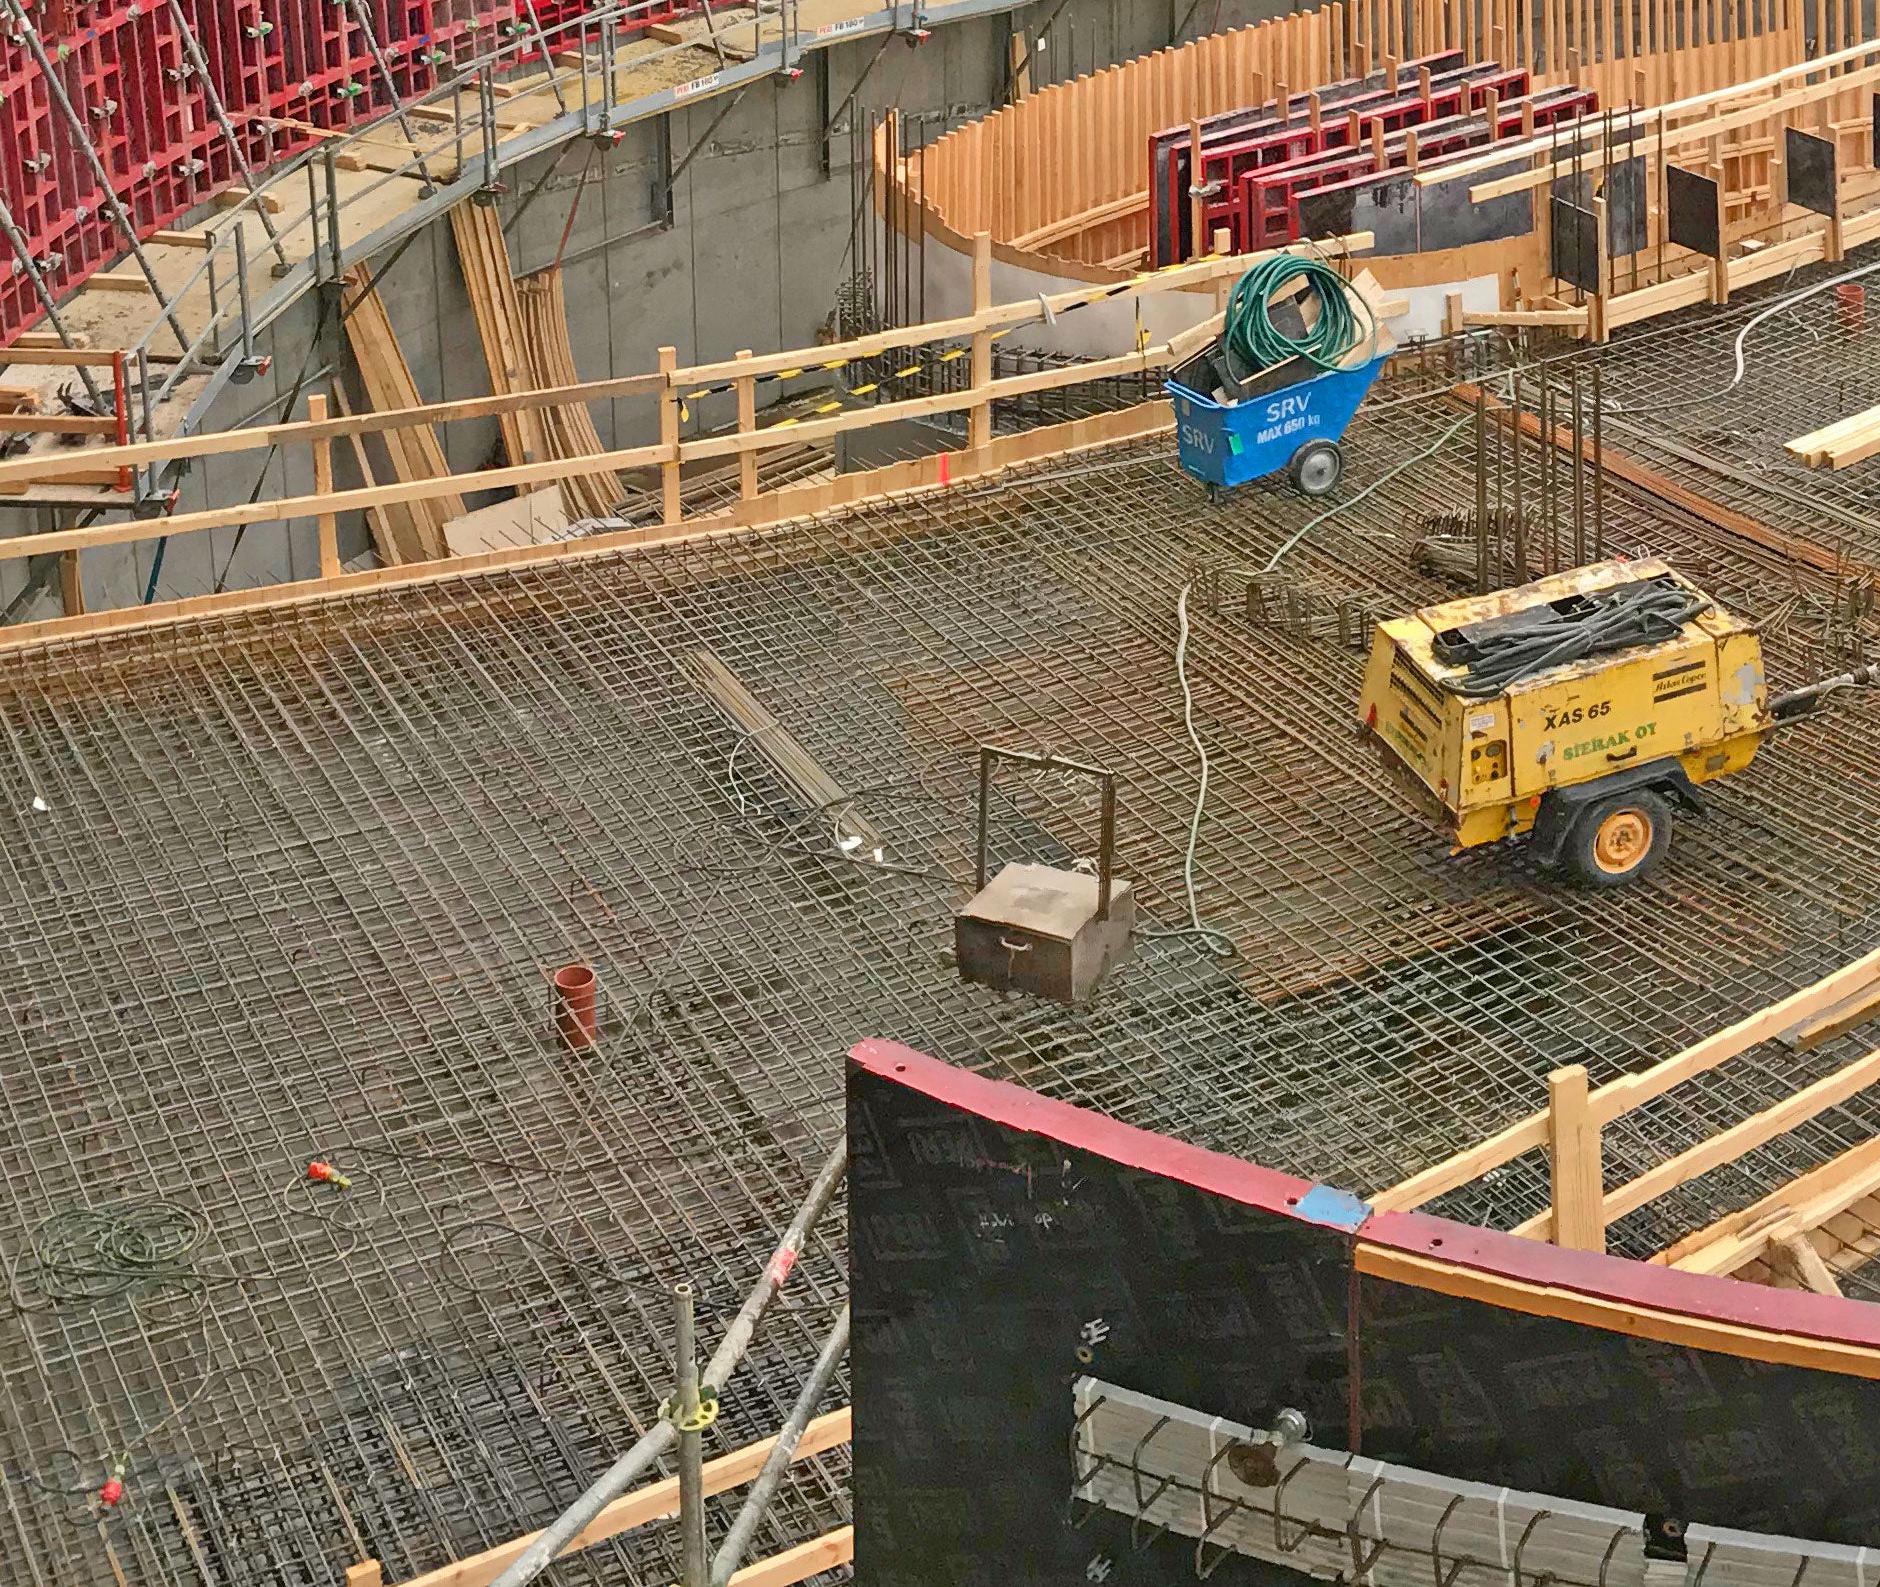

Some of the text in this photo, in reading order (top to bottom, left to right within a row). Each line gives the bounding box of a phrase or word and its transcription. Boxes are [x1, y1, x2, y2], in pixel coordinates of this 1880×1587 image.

[1266, 393, 1311, 423] SRV
[1182, 424, 1215, 455] SRV
[1257, 426, 1283, 445] MAX
[1284, 415, 1305, 434] 650
[1656, 679, 1681, 692] Atlas
[1543, 700, 1612, 732] XAS 65
[1563, 721, 1657, 761] SIERAK OY
